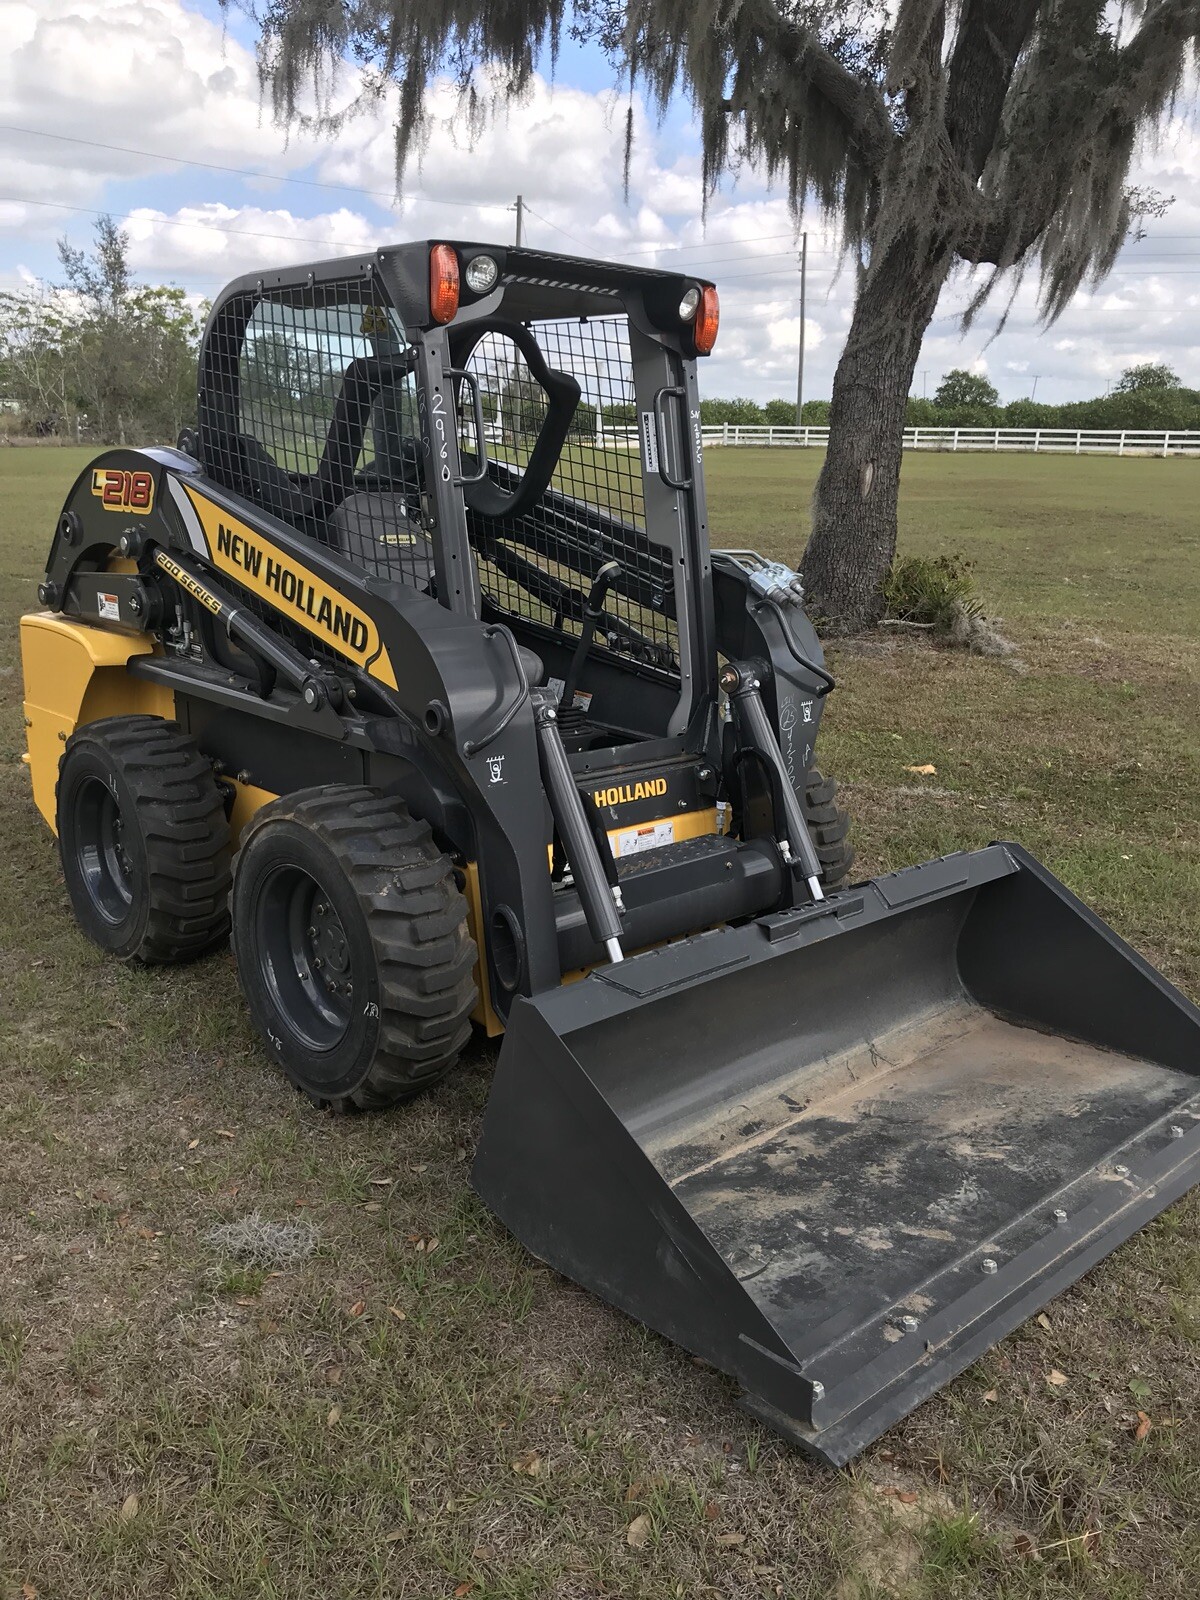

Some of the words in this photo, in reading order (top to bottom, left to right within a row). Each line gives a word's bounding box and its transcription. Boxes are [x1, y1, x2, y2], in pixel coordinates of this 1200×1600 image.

[432, 393, 451, 482] 2960
[92, 470, 153, 512] L218
[157, 554, 181, 578] 200
[181, 573, 222, 612] SERIES
[217, 523, 263, 578] NEW
[265, 557, 369, 653] HOLLAND
[594, 778, 668, 808] HOLLAND
